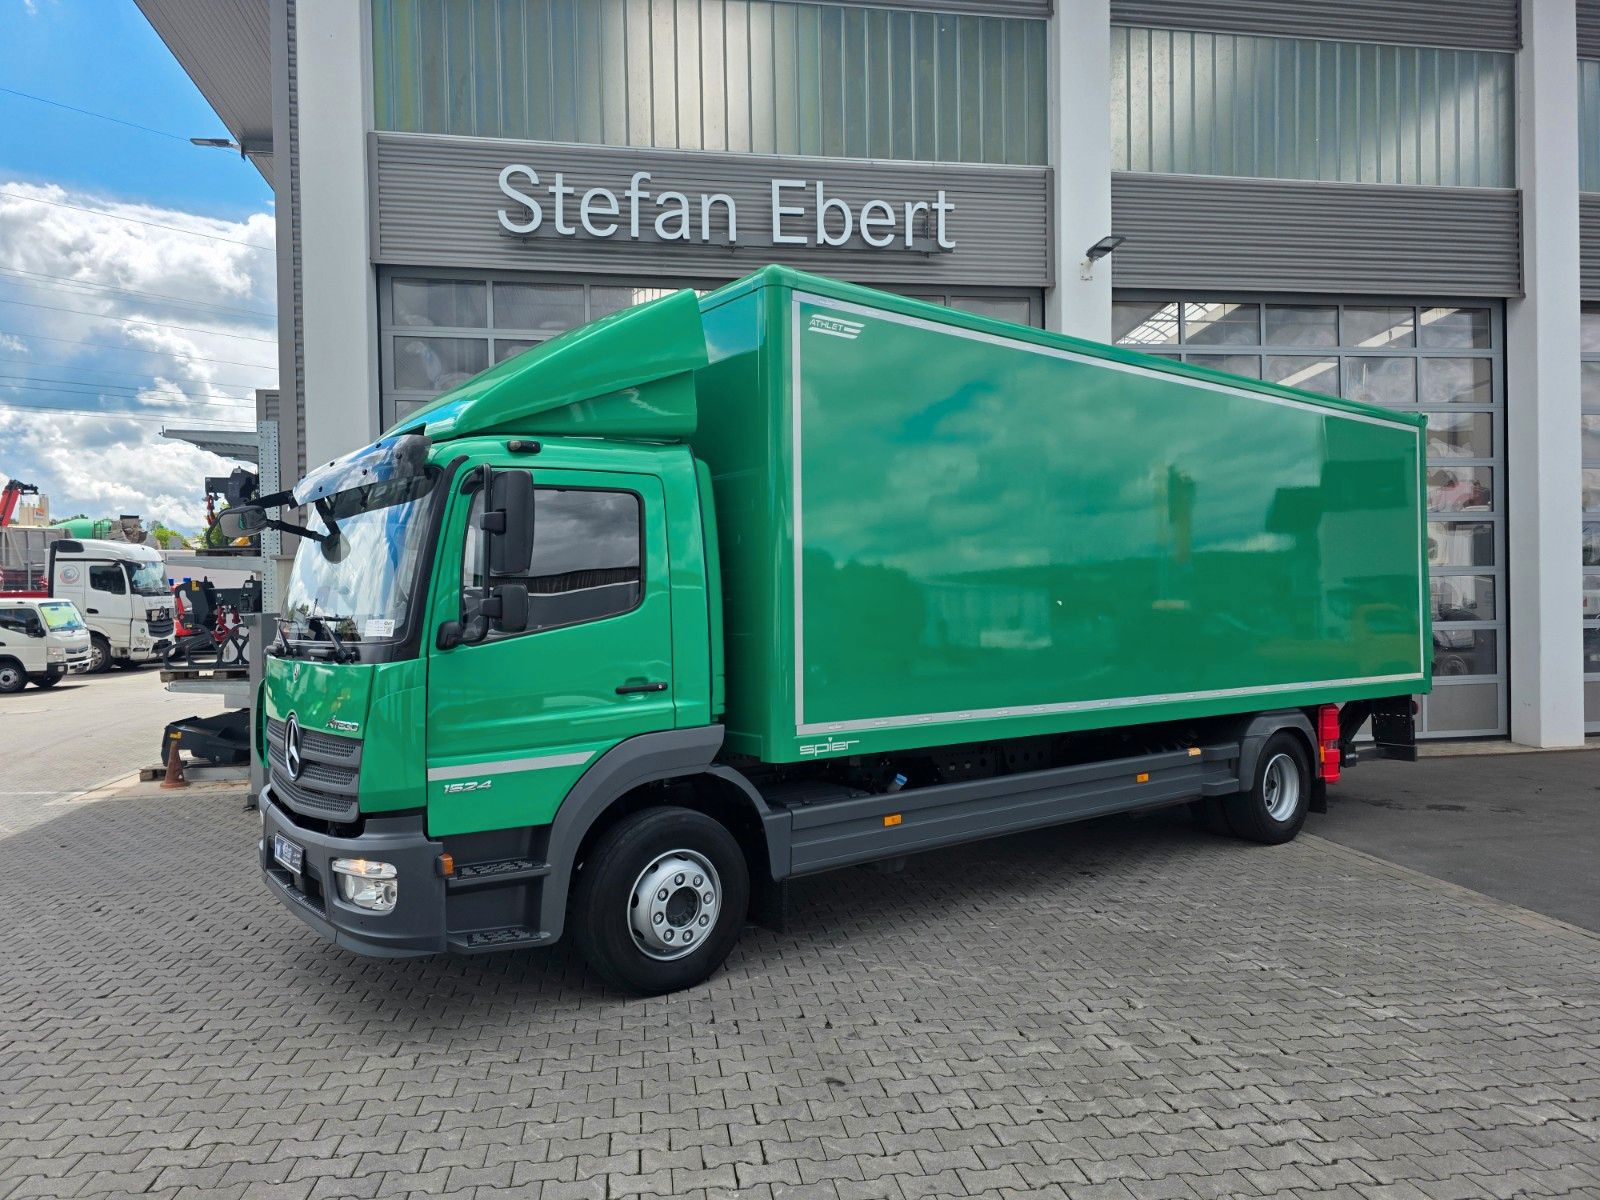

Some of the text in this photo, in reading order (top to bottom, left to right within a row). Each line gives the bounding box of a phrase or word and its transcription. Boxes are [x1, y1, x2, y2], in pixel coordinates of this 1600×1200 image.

[497, 164, 956, 249] Stefan Ebert
[809, 318, 844, 332] ATHLET
[800, 737, 860, 756] spier
[444, 780, 492, 793] 1524
